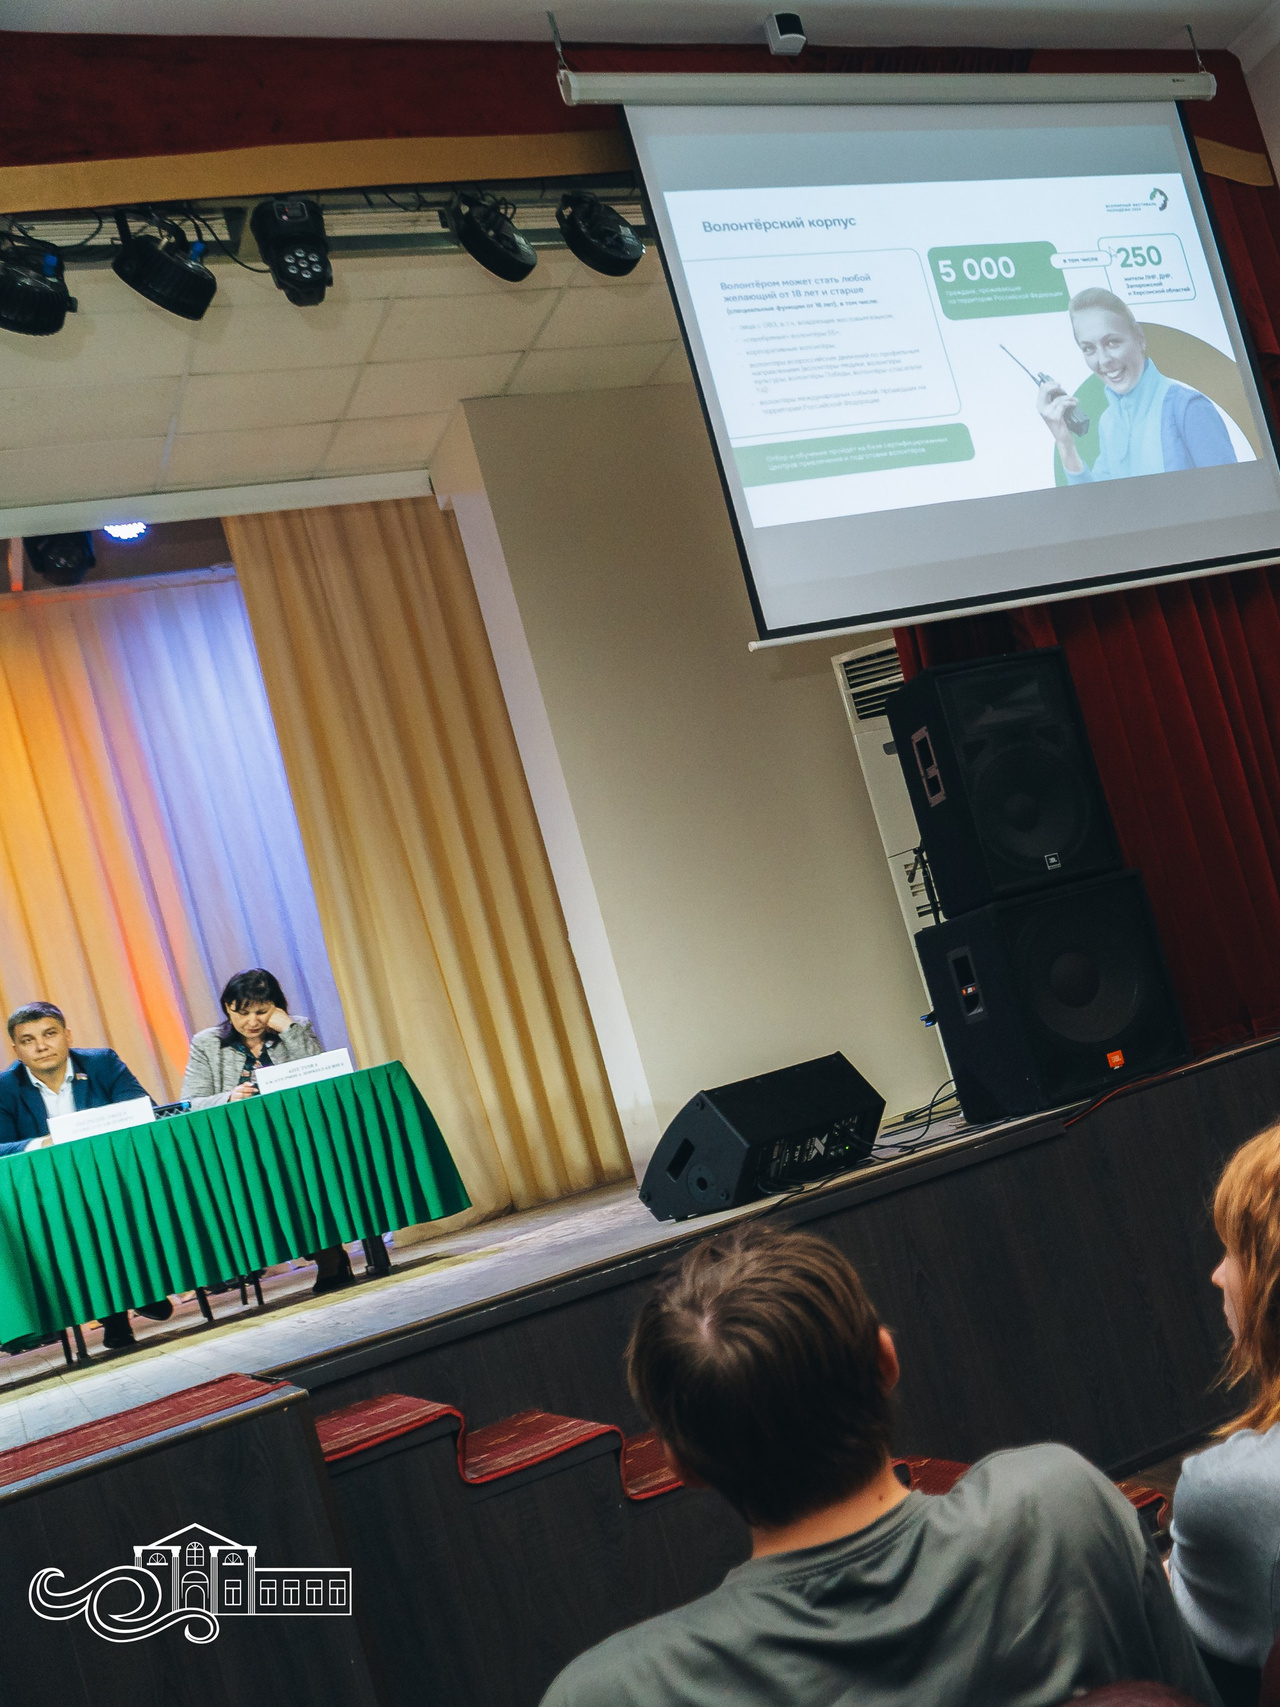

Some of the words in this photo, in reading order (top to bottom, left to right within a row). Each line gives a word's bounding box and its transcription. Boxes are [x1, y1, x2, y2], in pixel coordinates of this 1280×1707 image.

[703, 217, 804, 233] Волонтёрский
[808, 217, 856, 230] корпус
[1116, 246, 1162, 266] 250
[938, 260, 956, 281] 5
[962, 257, 1016, 280] 000
[720, 279, 779, 290] Волонтёром
[841, 273, 870, 282] любой
[723, 291, 776, 302] желающий
[830, 287, 863, 296] старше
